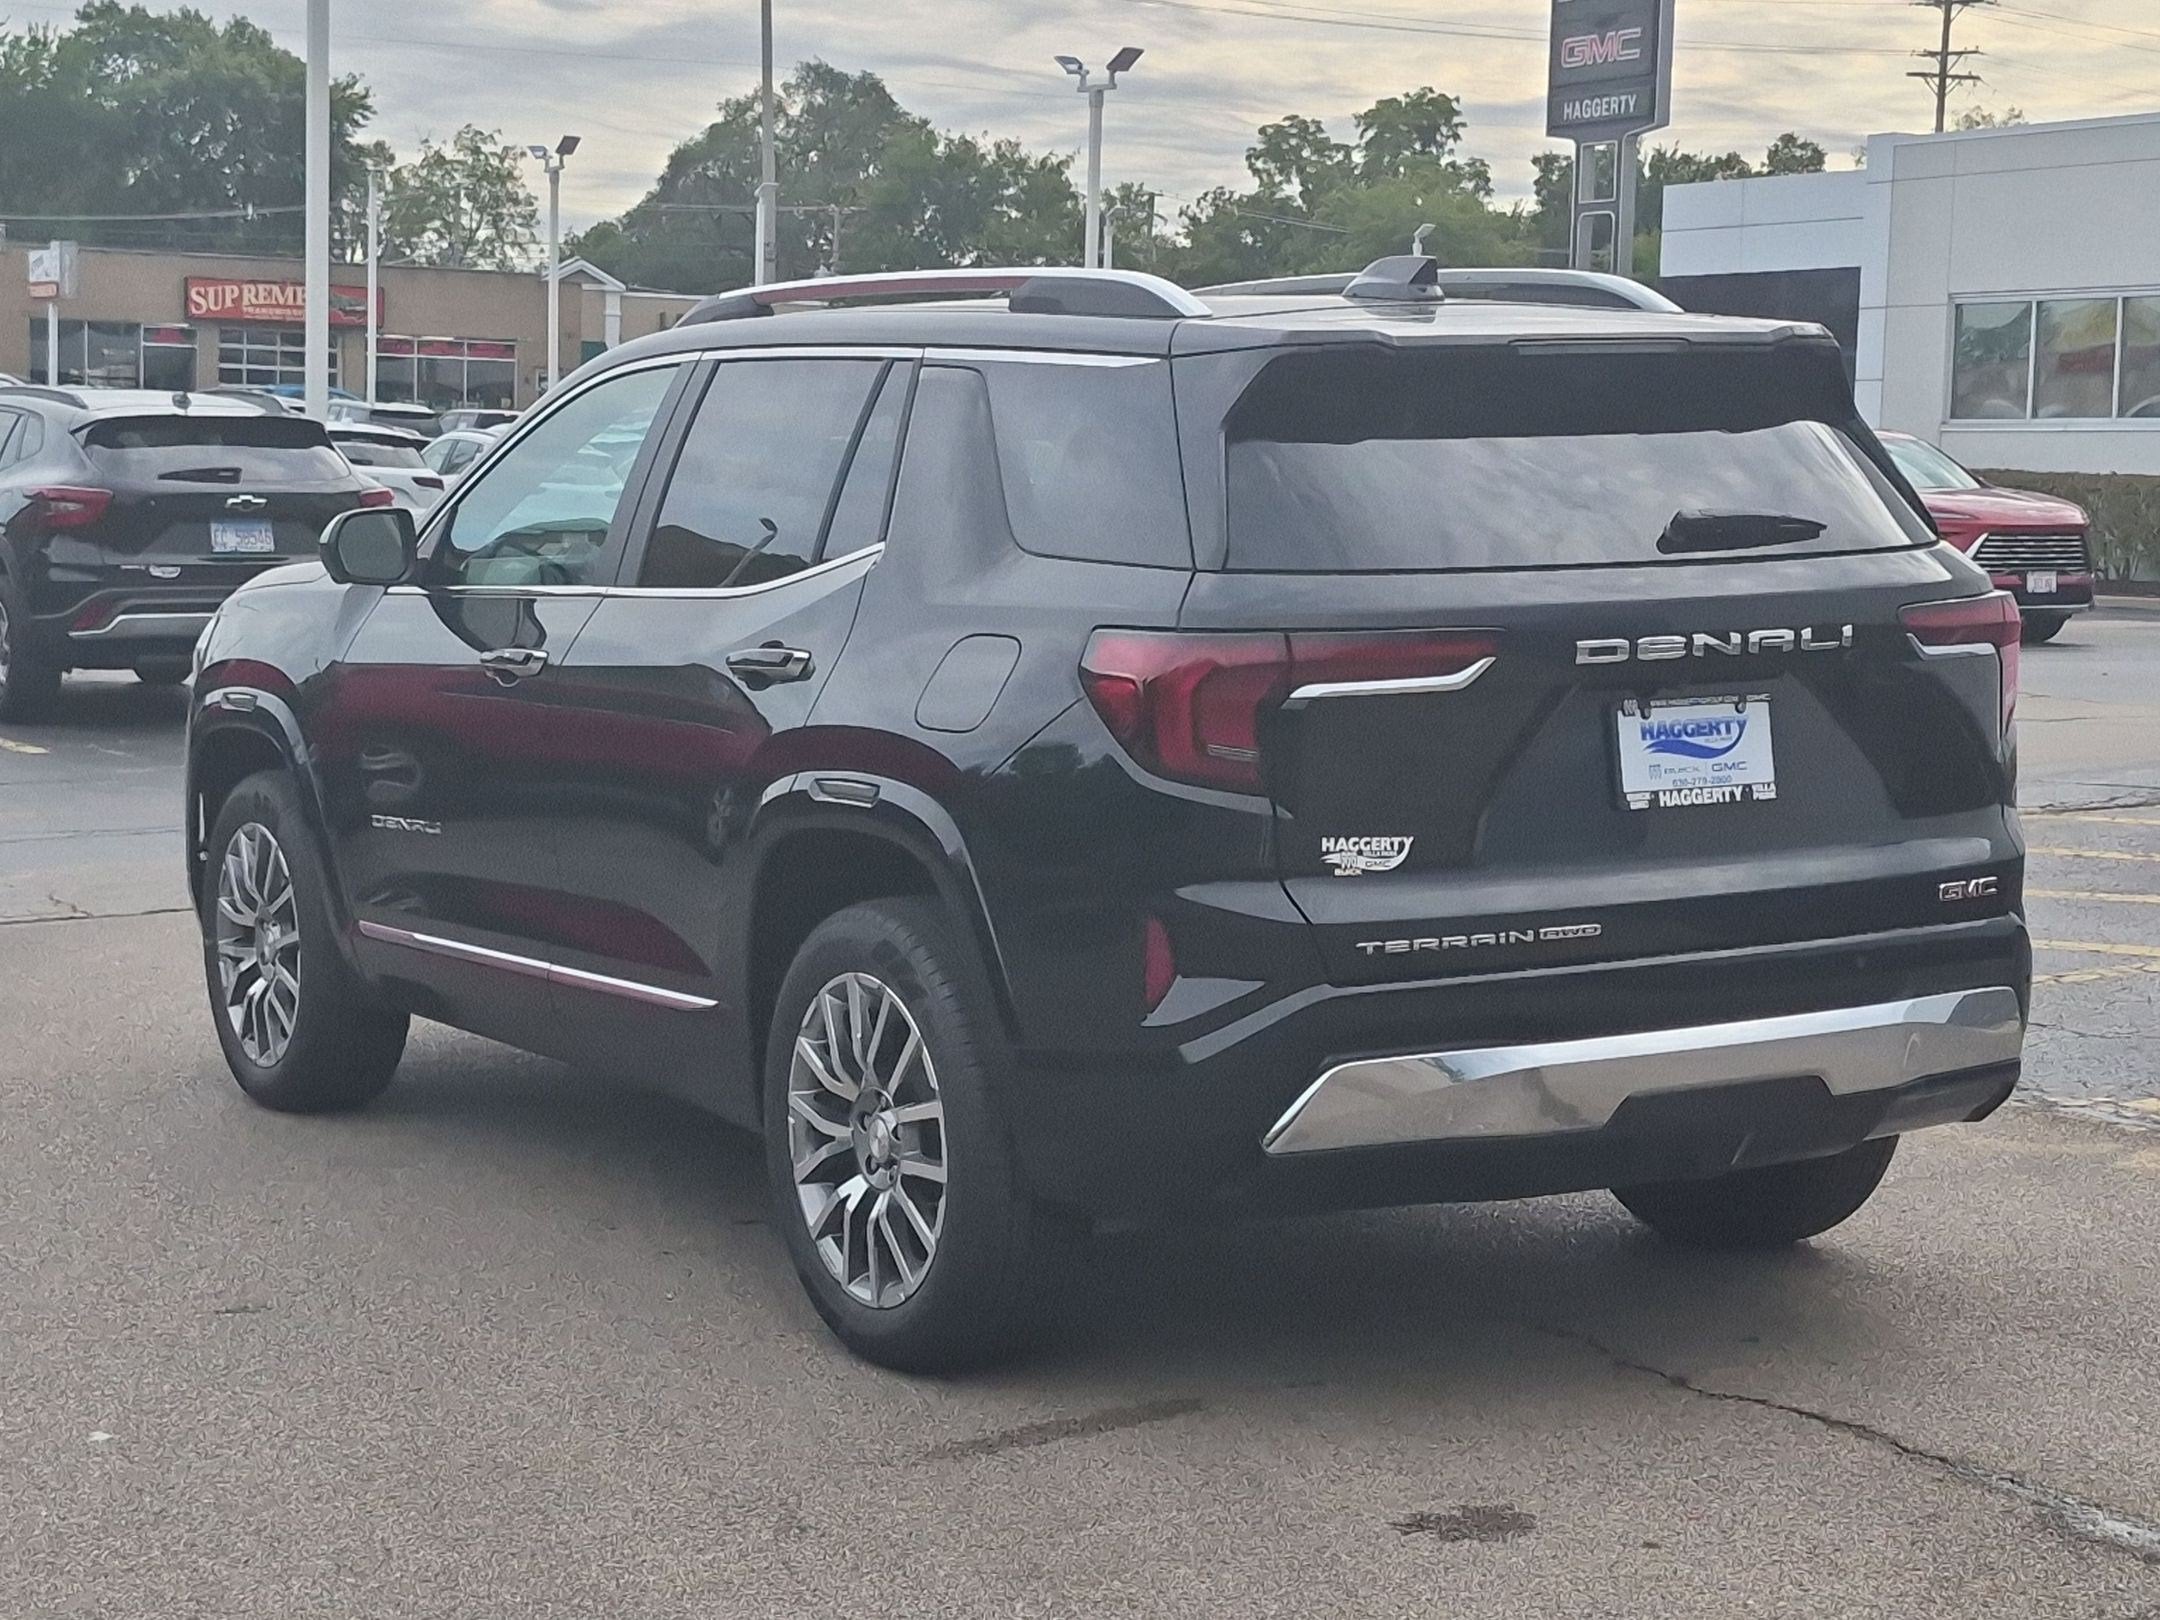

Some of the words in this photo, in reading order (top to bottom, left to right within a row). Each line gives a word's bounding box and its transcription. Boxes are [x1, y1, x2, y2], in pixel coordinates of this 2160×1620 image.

[1561, 27, 1641, 68] GMC
[1563, 94, 1637, 120] HAGGERTY
[1575, 624, 1853, 665] DENALI
[1640, 715, 1748, 742] HAGGERTY
[1711, 760, 1748, 772] GMC
[1658, 785, 1744, 807] HAGGERTY
[1321, 836, 1414, 852] HAGGERTY
[1939, 876, 1998, 901] GMC
[1356, 930, 1534, 955] TERRAIN
